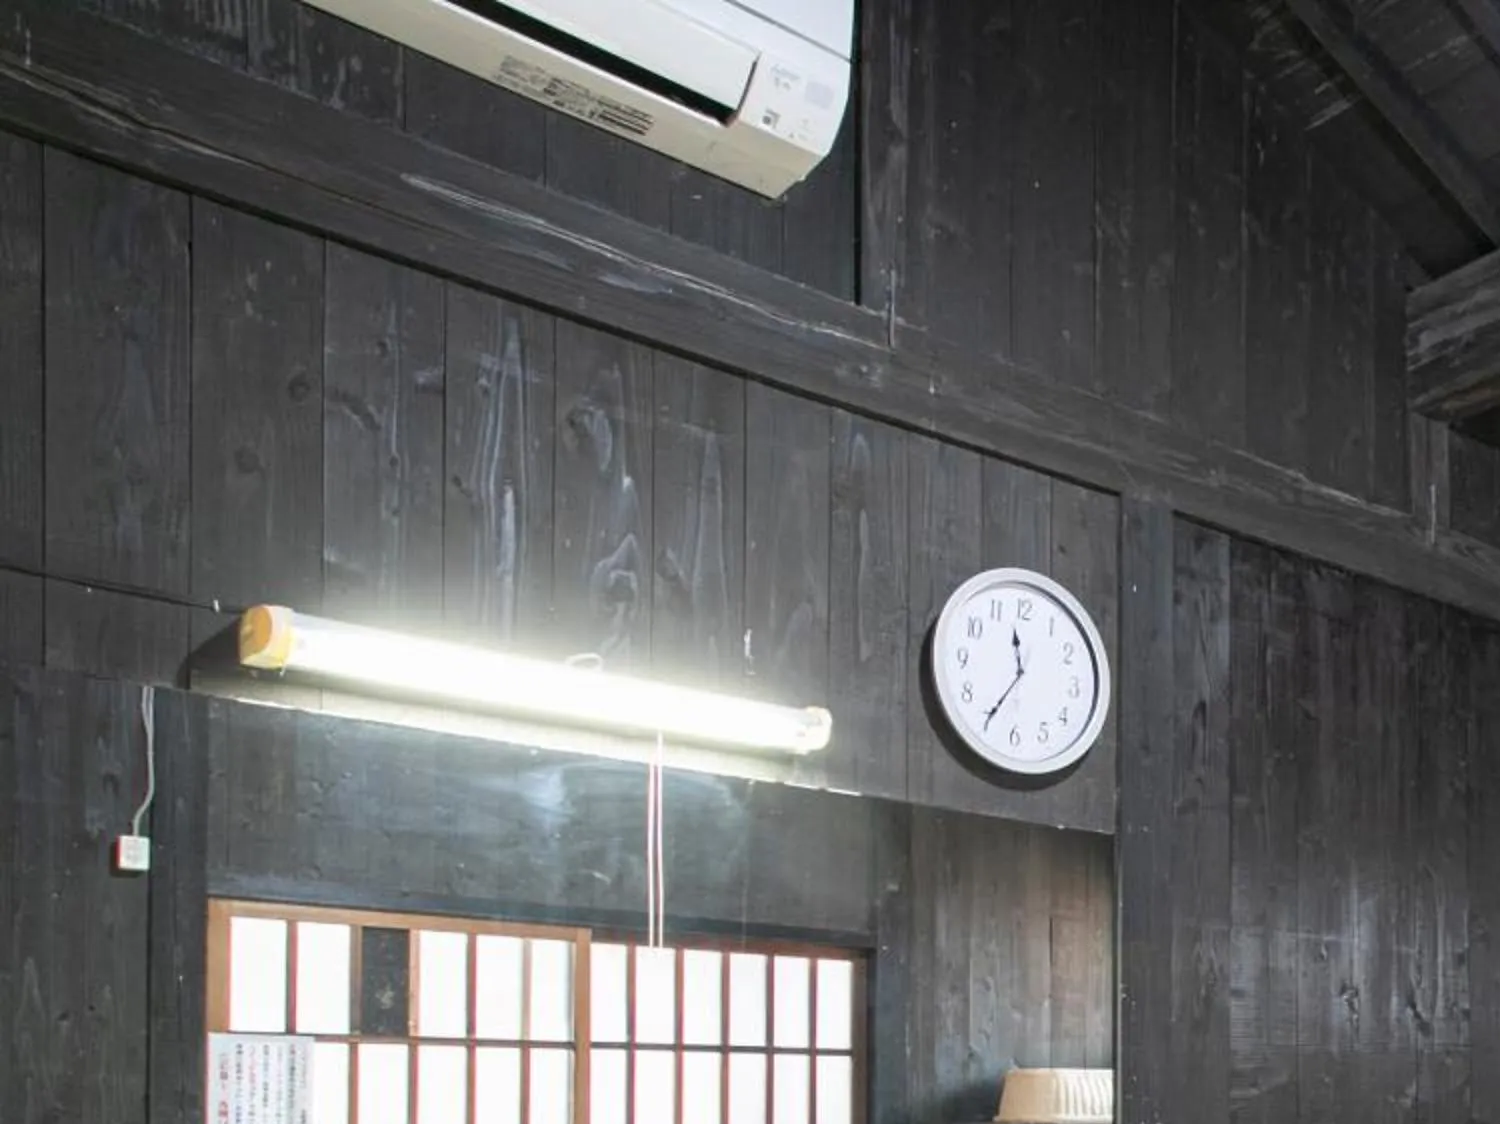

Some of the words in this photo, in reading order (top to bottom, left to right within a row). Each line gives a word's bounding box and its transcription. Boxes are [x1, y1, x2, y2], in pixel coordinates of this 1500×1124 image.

[990, 600, 1002, 621] 11
[1017, 598, 1032, 621] 12
[967, 616, 983, 640] 10
[1049, 617, 1055, 637] 1
[957, 647, 968, 669] 9
[1063, 642, 1074, 665] 2
[961, 681, 973, 703] 8
[1068, 676, 1080, 698] 3
[1058, 707, 1068, 726] 4
[1009, 724, 1021, 746] 6
[1037, 721, 1049, 744] 5
